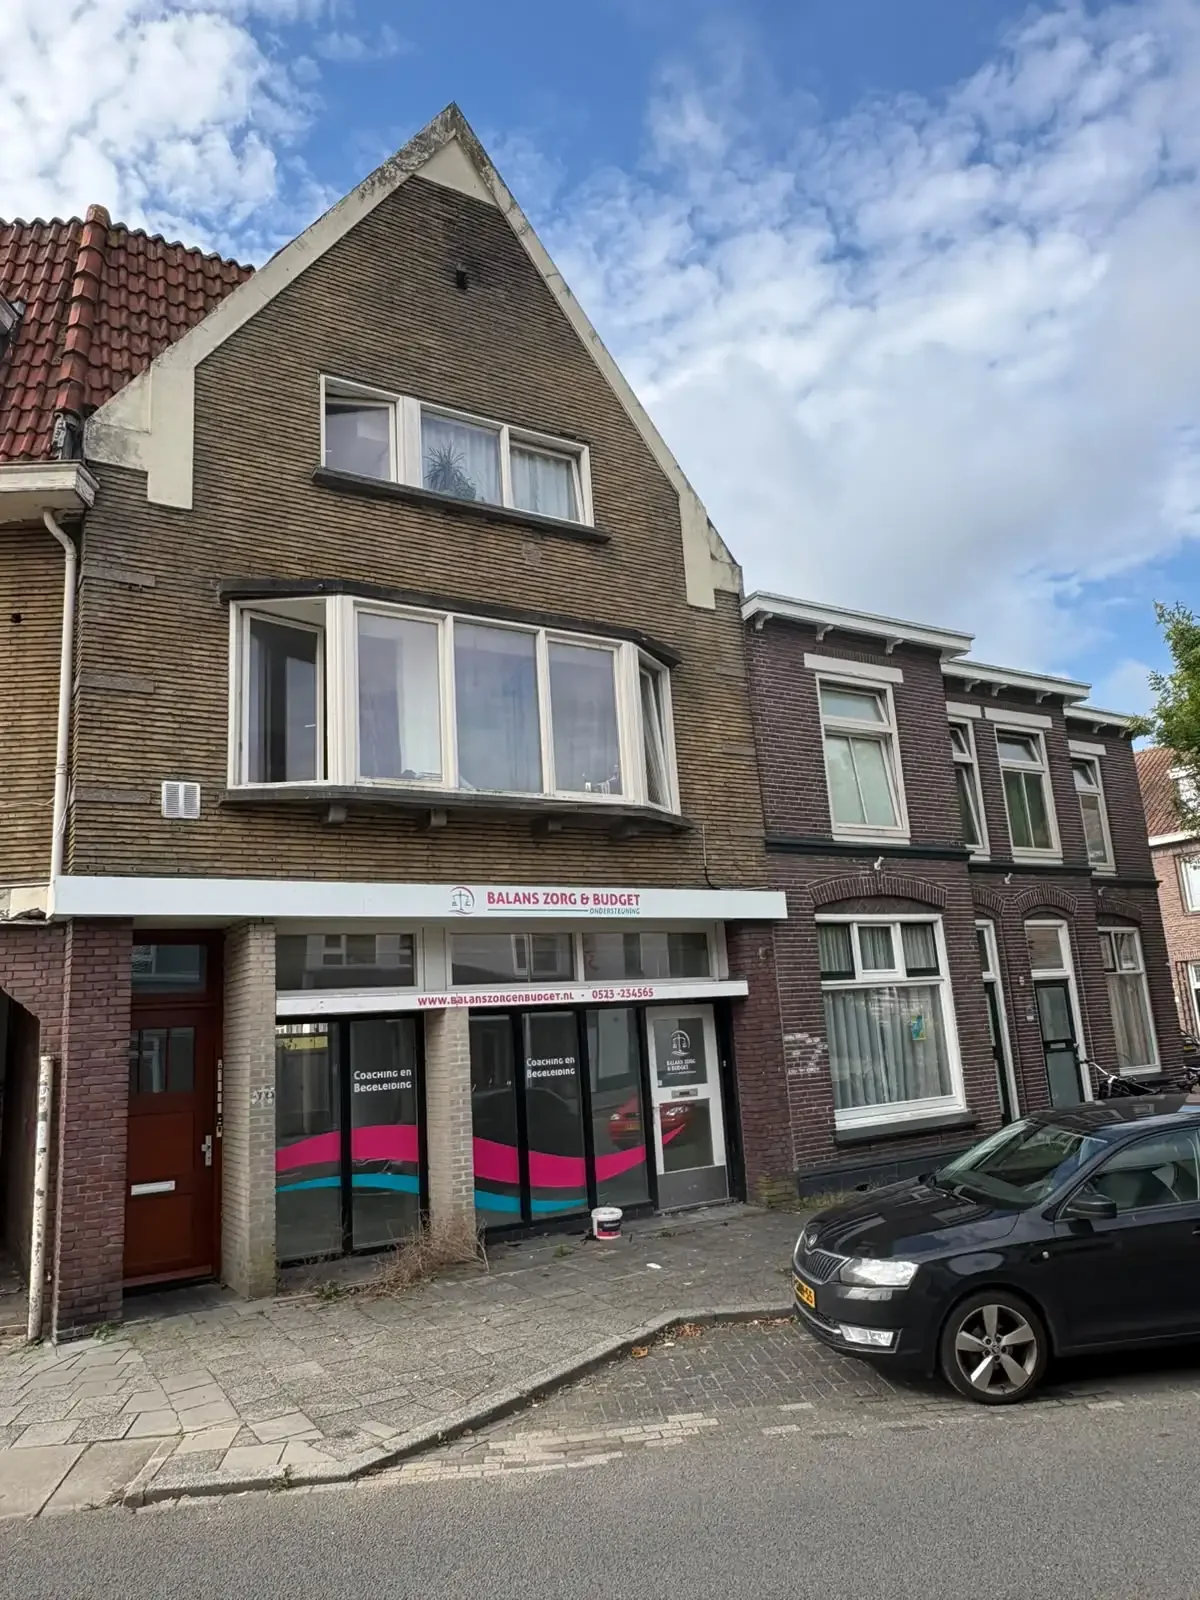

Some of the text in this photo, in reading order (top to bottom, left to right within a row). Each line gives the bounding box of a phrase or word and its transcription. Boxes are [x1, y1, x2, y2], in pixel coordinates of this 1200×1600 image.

[487, 891, 640, 906] BALANS ZORG & BUDGET
[565, 1056, 576, 1064] en
[400, 1069, 412, 1077] en
